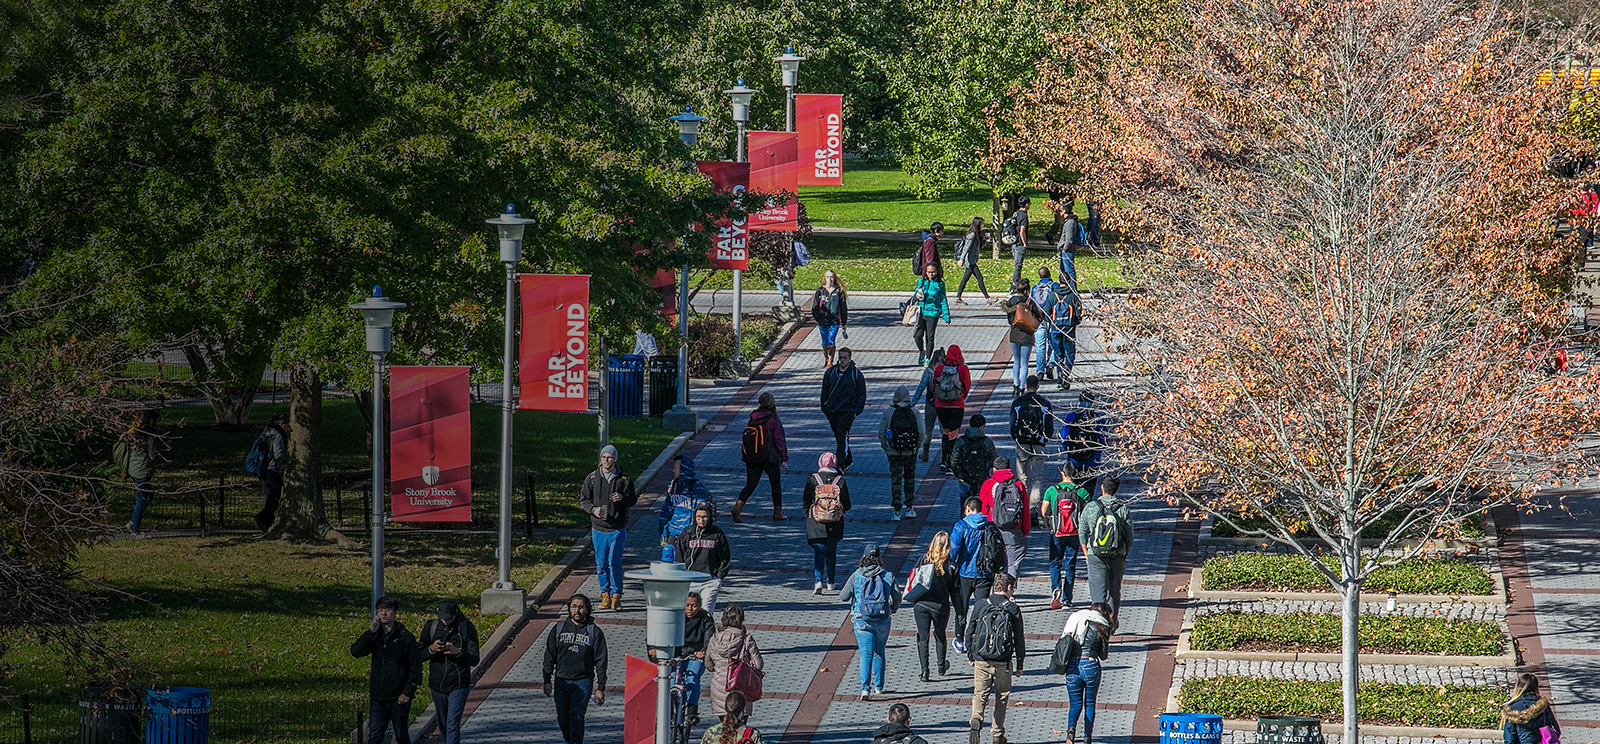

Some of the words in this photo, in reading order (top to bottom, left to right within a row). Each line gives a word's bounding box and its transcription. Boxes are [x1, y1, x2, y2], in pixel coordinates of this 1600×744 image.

[827, 113, 840, 178] BEYOND
[815, 148, 828, 178] FAR
[758, 214, 787, 222] University
[566, 303, 585, 399] BEYOND
[547, 356, 566, 398] FAR
[405, 487, 430, 498] Stony
[430, 487, 457, 497] Brook
[409, 497, 453, 507] University
[1169, 731, 1194, 739] BOTTLES
